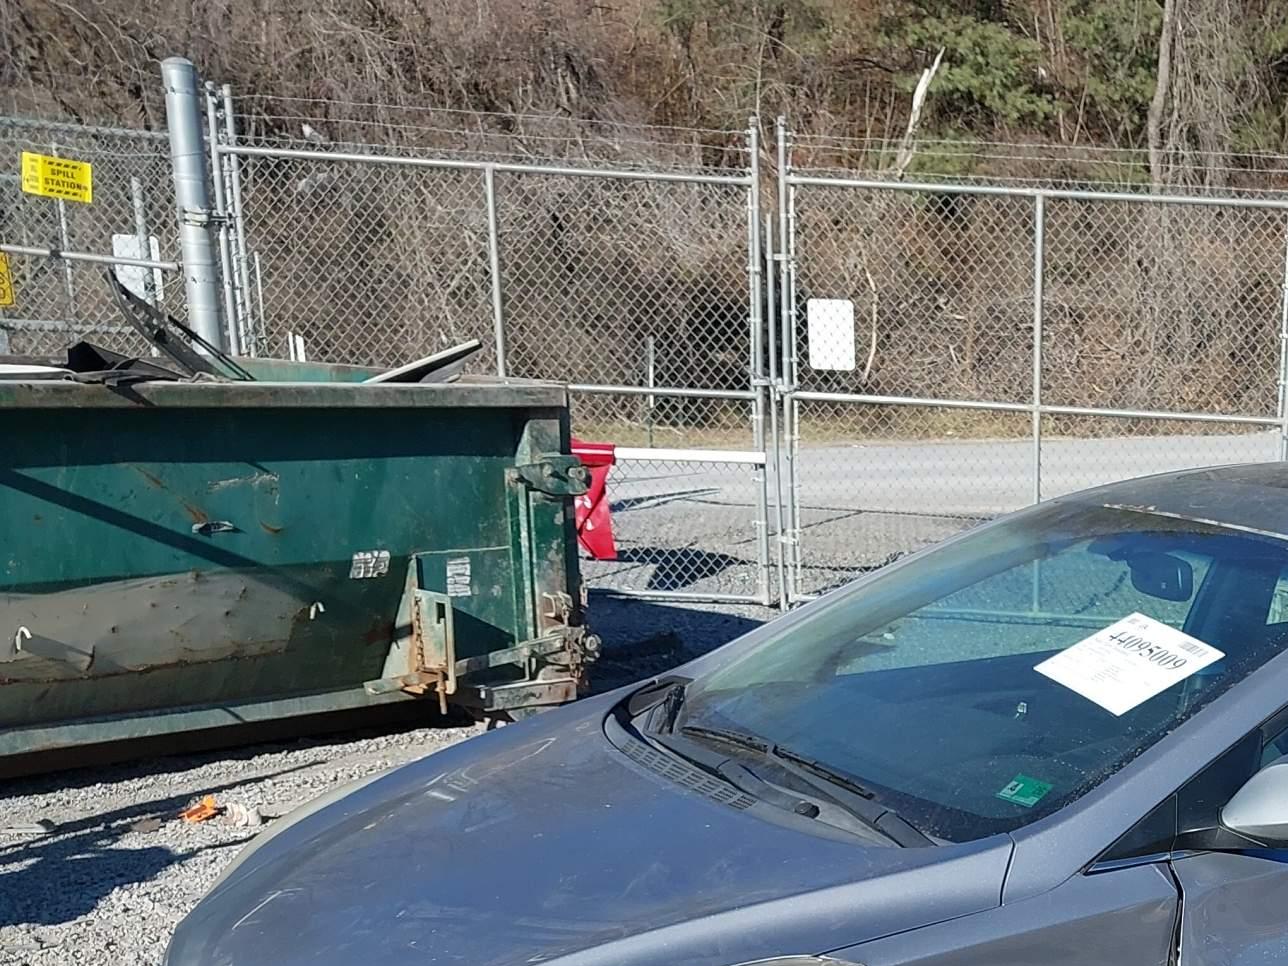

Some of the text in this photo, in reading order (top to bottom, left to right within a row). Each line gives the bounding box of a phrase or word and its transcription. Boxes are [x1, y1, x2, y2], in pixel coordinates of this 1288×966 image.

[51, 168, 75, 179] SPILL
[44, 177, 82, 190] STATION
[1109, 631, 1187, 670] 44095009
